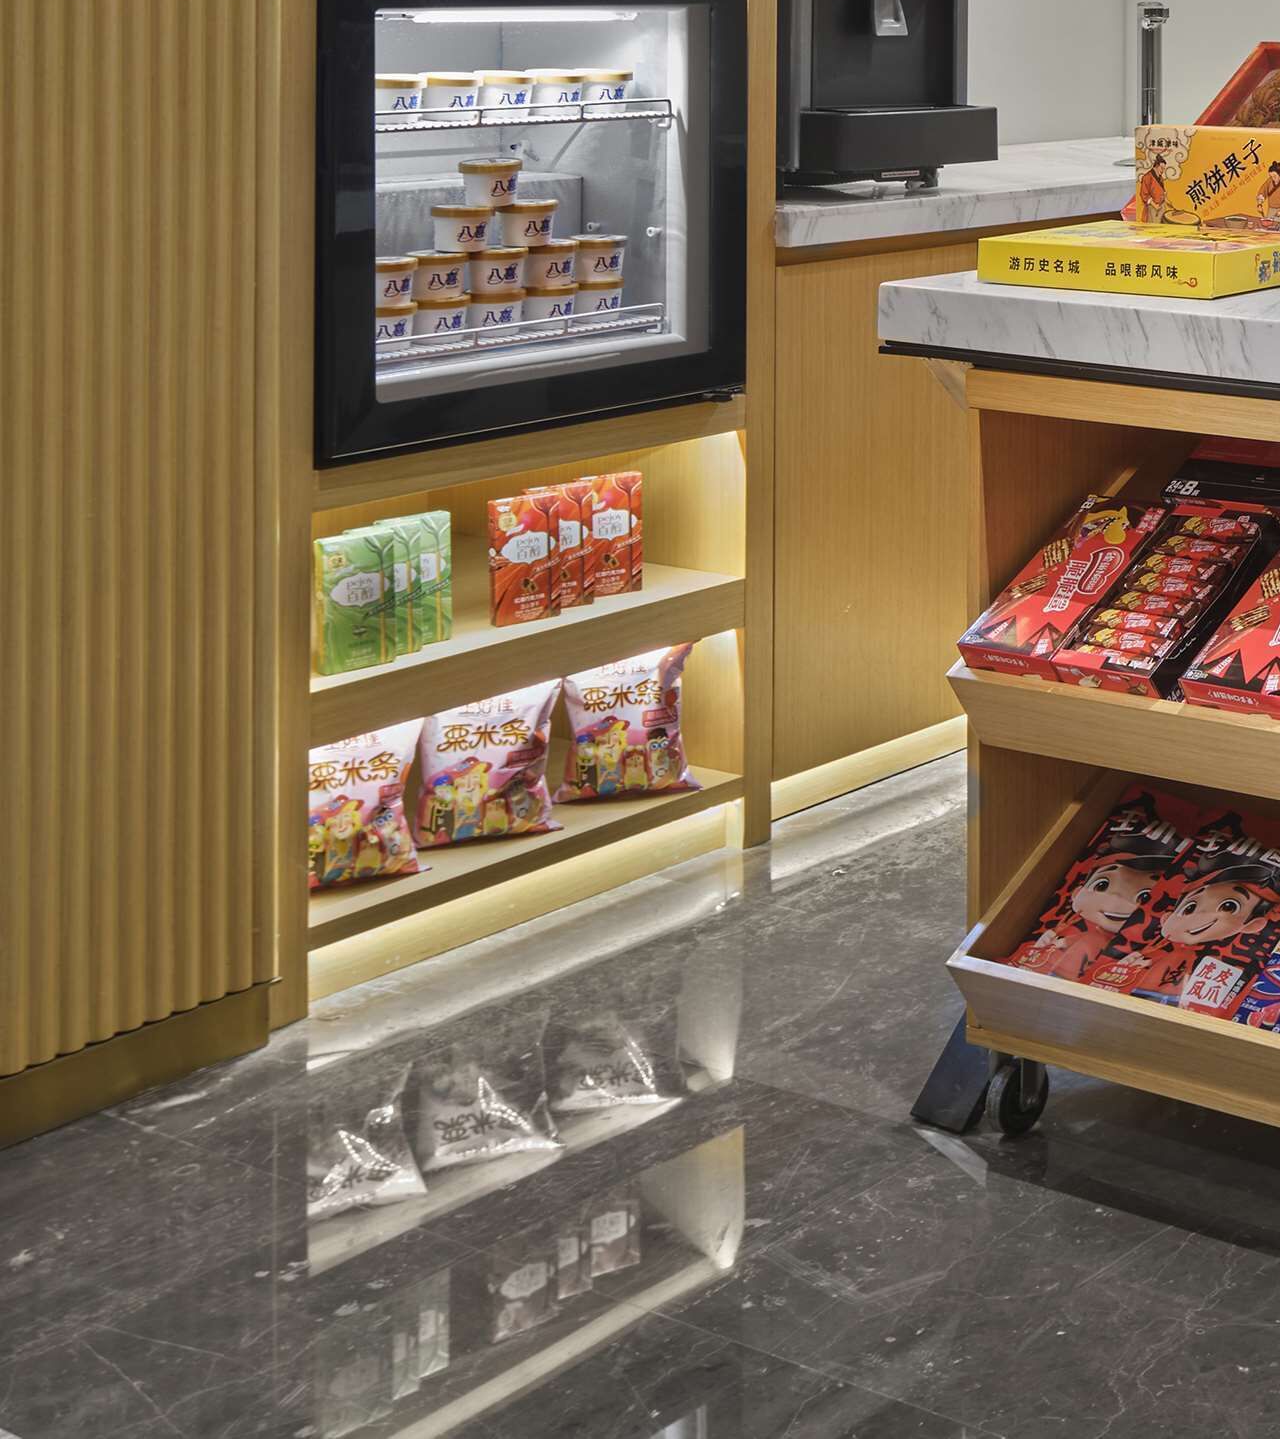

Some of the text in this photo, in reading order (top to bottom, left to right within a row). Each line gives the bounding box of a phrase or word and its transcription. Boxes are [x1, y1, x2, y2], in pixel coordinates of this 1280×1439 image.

[393, 93, 418, 109] 八喜
[501, 90, 526, 105] 八喜
[600, 83, 625, 100] 八喜
[1185, 137, 1263, 211] 煎饼果子
[491, 175, 518, 197] 八喜
[457, 221, 488, 243] 八喜
[525, 216, 551, 237] 八喜
[547, 258, 575, 280] 八喜
[594, 251, 622, 273] 八喜
[1008, 255, 1179, 281] 游历史名城 品哏都风味
[428, 268, 460, 291] 八喜
[488, 263, 518, 285] 八喜
[384, 275, 411, 298] 八喜
[597, 295, 620, 312] 八喜
[435, 314, 462, 333] 八喜
[483, 306, 513, 326] 八喜
[377, 319, 407, 338] 八喜
[1042, 559, 1090, 613] 脆脆鲨
[1195, 961, 1233, 987] 虎皮
[1186, 979, 1219, 1004] 凤爪
